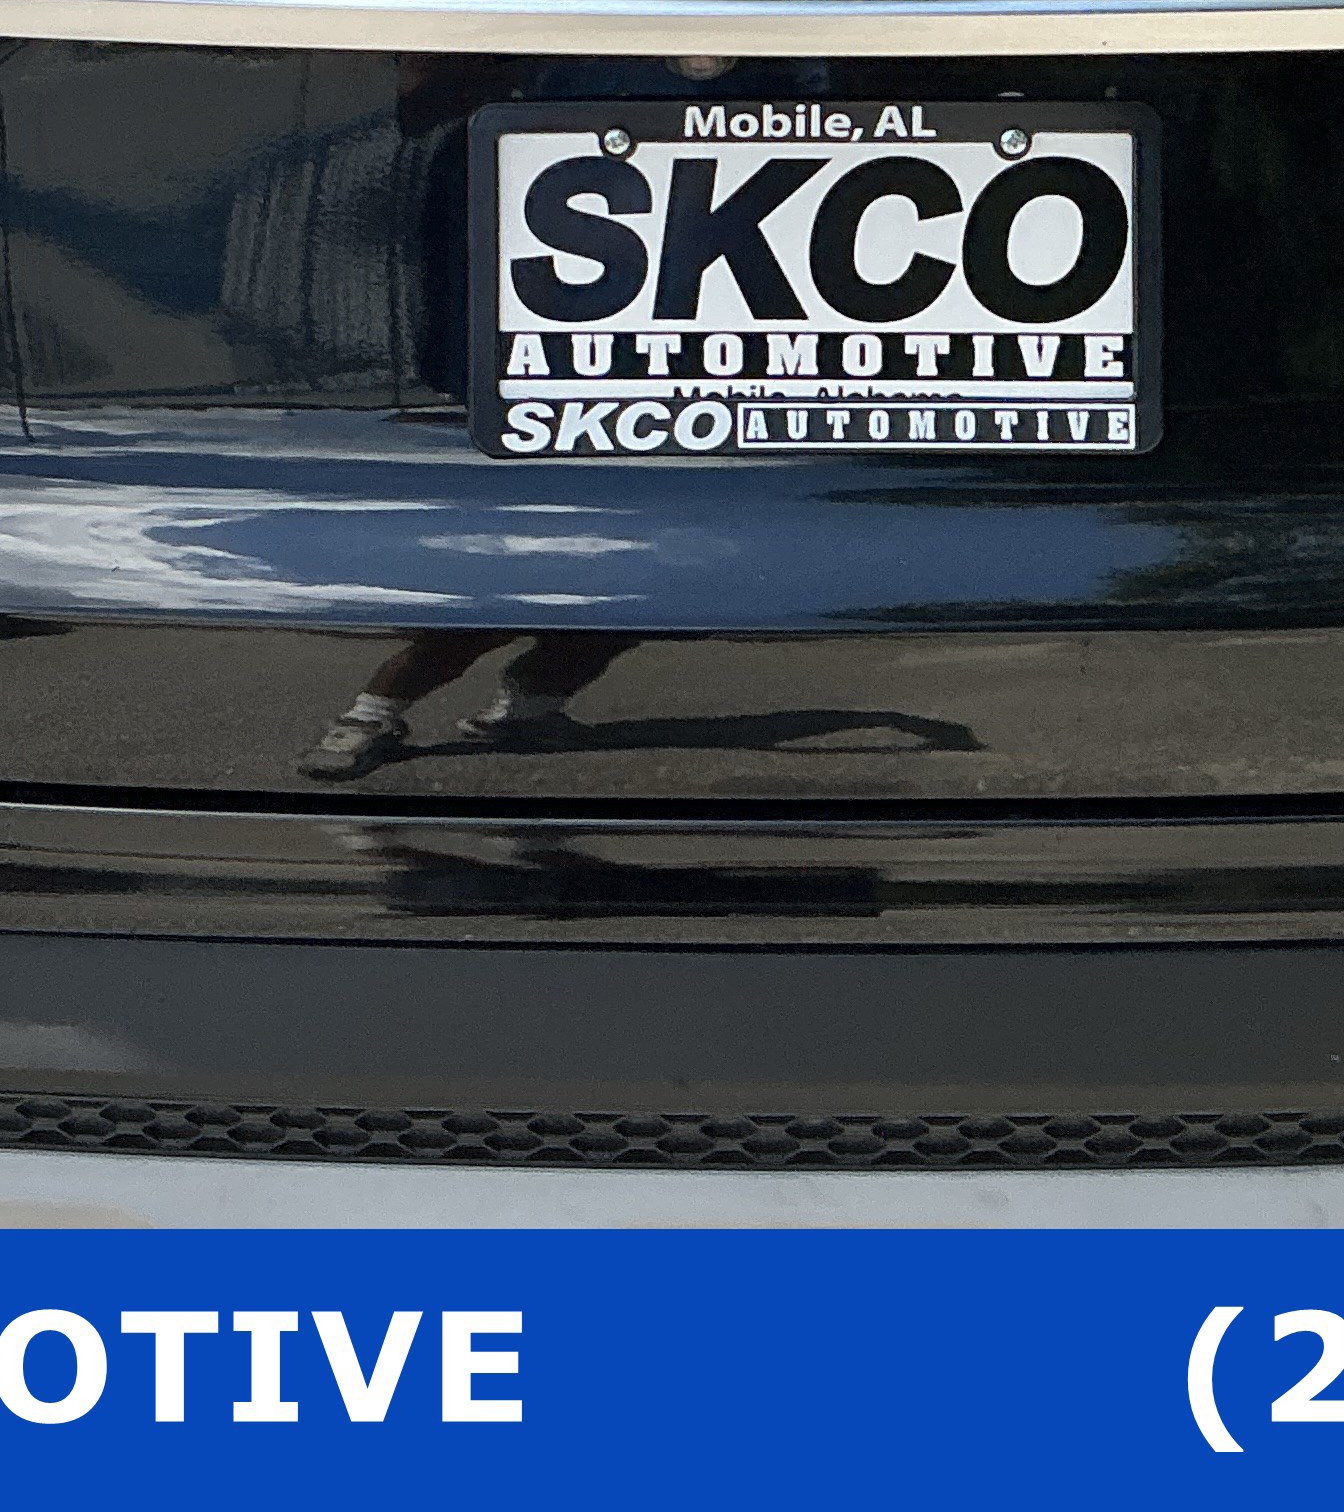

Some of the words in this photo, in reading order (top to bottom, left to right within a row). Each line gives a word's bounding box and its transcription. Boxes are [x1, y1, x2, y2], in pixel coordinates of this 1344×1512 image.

[684, 104, 863, 141] Mobile,
[873, 105, 937, 138] AL
[509, 155, 1129, 324] SKCO
[506, 334, 1124, 377] AUTOMOTIVE
[501, 400, 733, 452] SKCO
[745, 409, 1131, 441] AUTOMOTIVE
